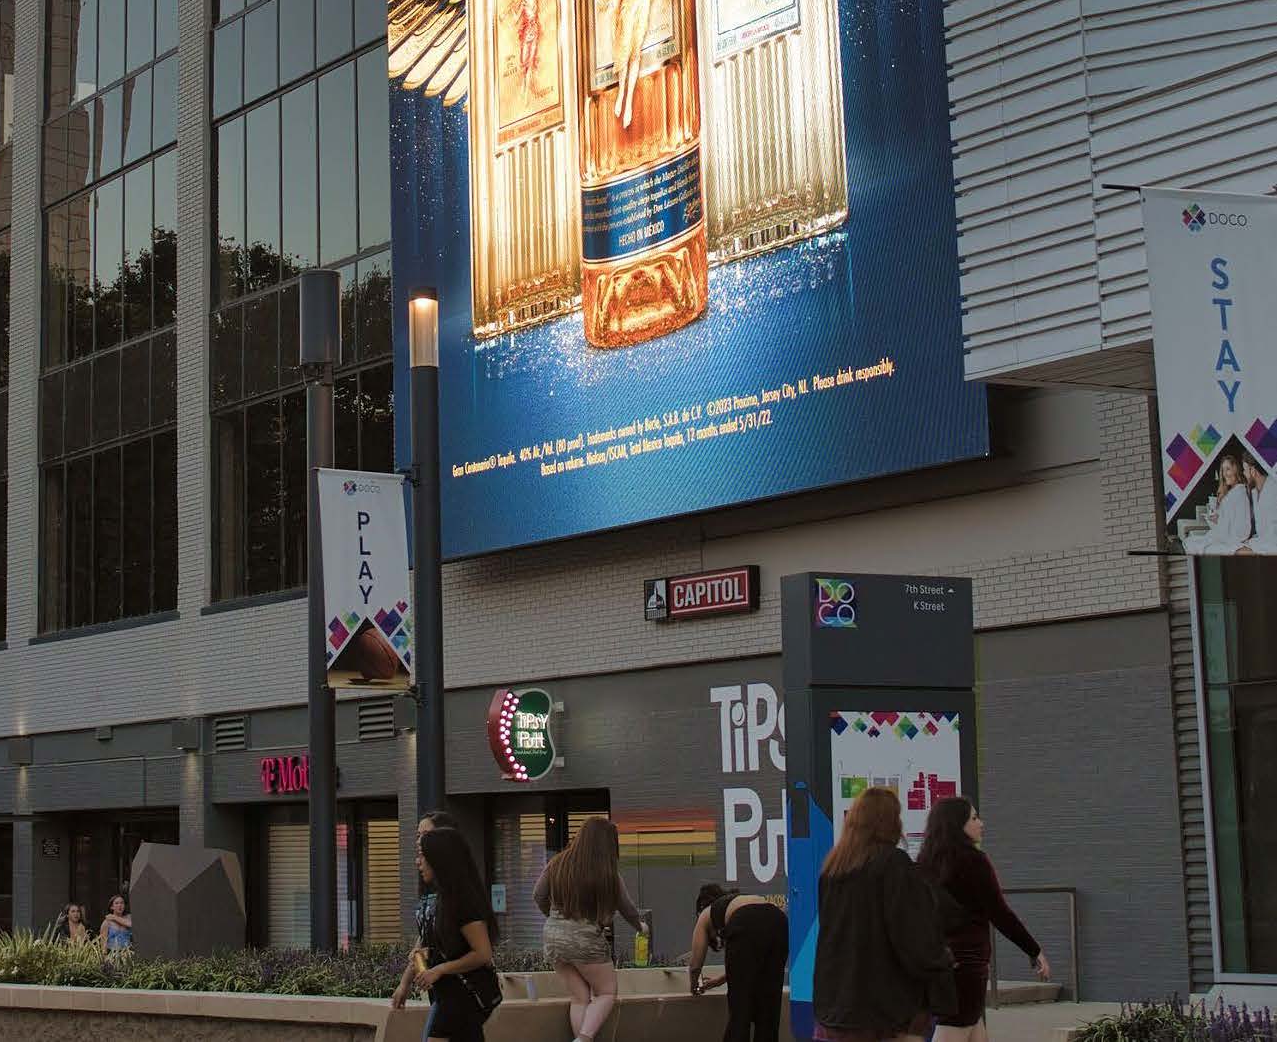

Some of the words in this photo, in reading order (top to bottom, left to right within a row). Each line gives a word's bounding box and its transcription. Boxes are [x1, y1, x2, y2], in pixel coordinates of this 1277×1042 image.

[1209, 212, 1248, 227] DOCO
[1210, 257, 1241, 413] STAY
[761, 389, 781, 403] Jersey
[812, 374, 835, 391] Please
[836, 366, 854, 385] drink
[855, 357, 895, 381] responsibly.
[686, 428, 696, 442] 12
[718, 415, 738, 435] ended
[357, 511, 373, 604] PLAY
[674, 577, 744, 608] CAPITOL
[905, 584, 918, 594] 7th
[920, 584, 944, 595] Street
[913, 601, 919, 611] K
[919, 601, 945, 611] Street
